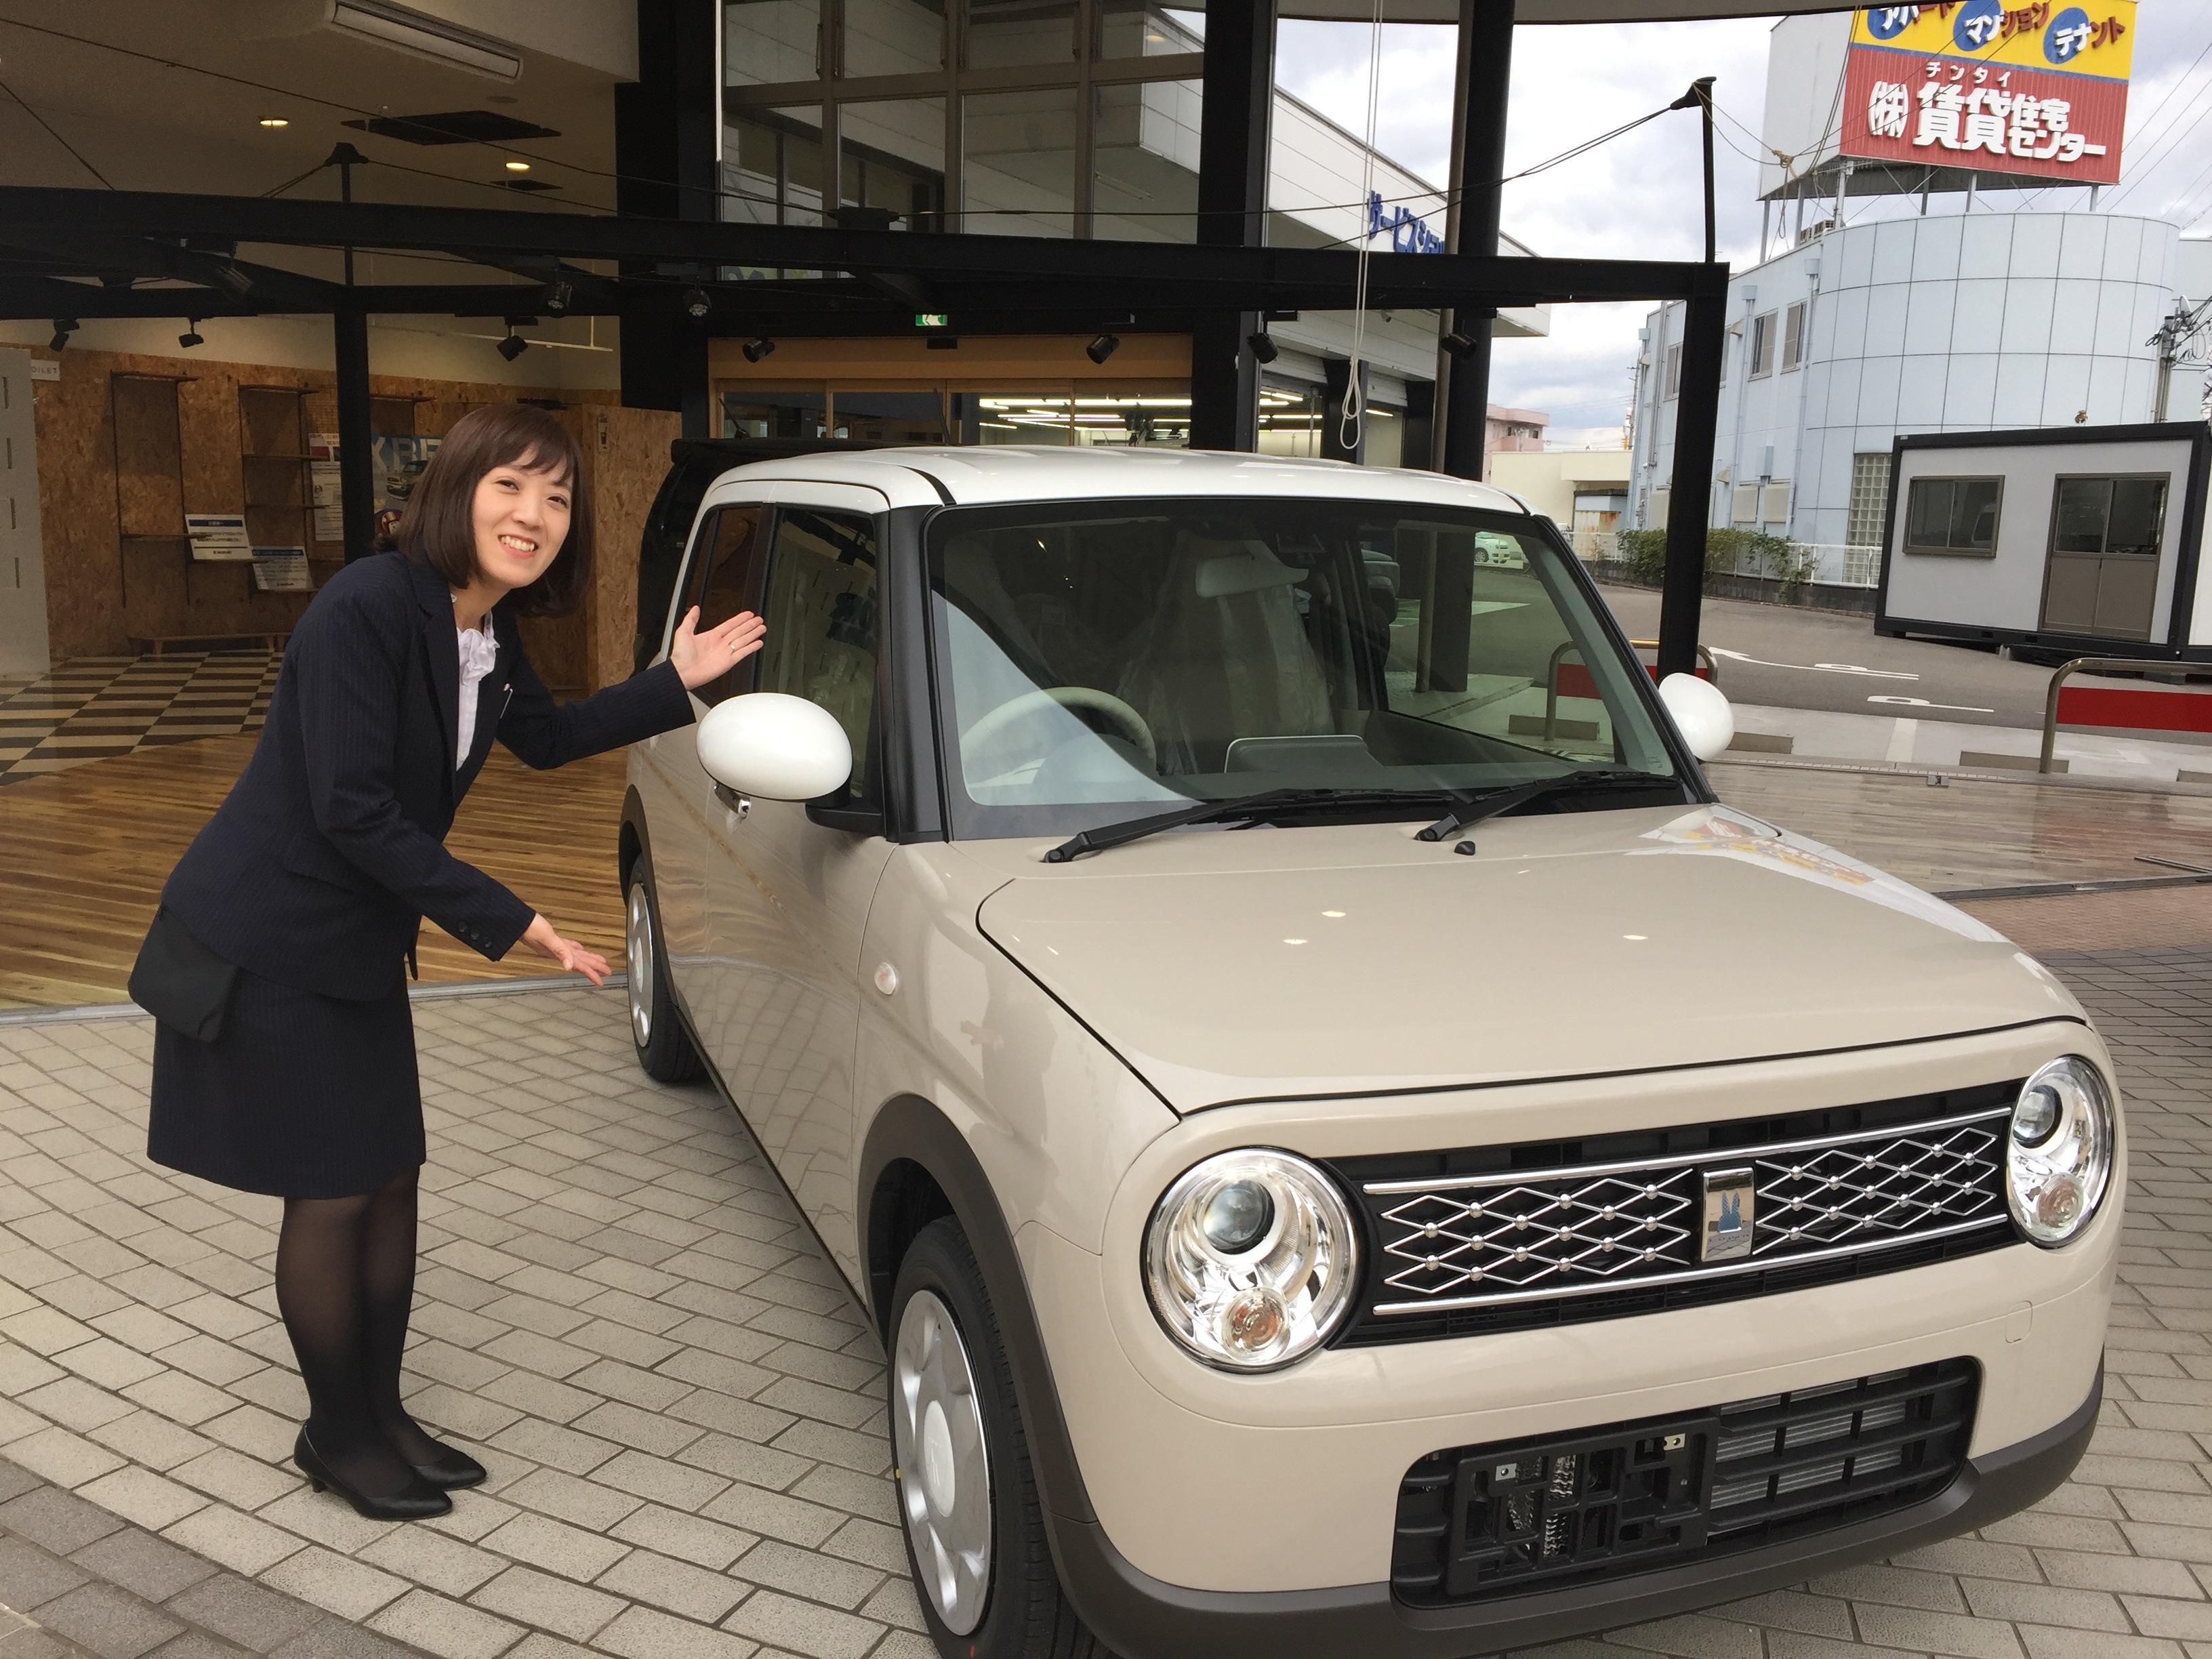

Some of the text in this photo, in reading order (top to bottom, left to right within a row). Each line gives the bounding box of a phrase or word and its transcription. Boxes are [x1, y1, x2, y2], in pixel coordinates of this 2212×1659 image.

[1964, 1, 2051, 44] マンション
[2053, 16, 2126, 57] テナント
[1926, 62, 2011, 87] チンタイ
[30, 365, 58, 375] OILET
